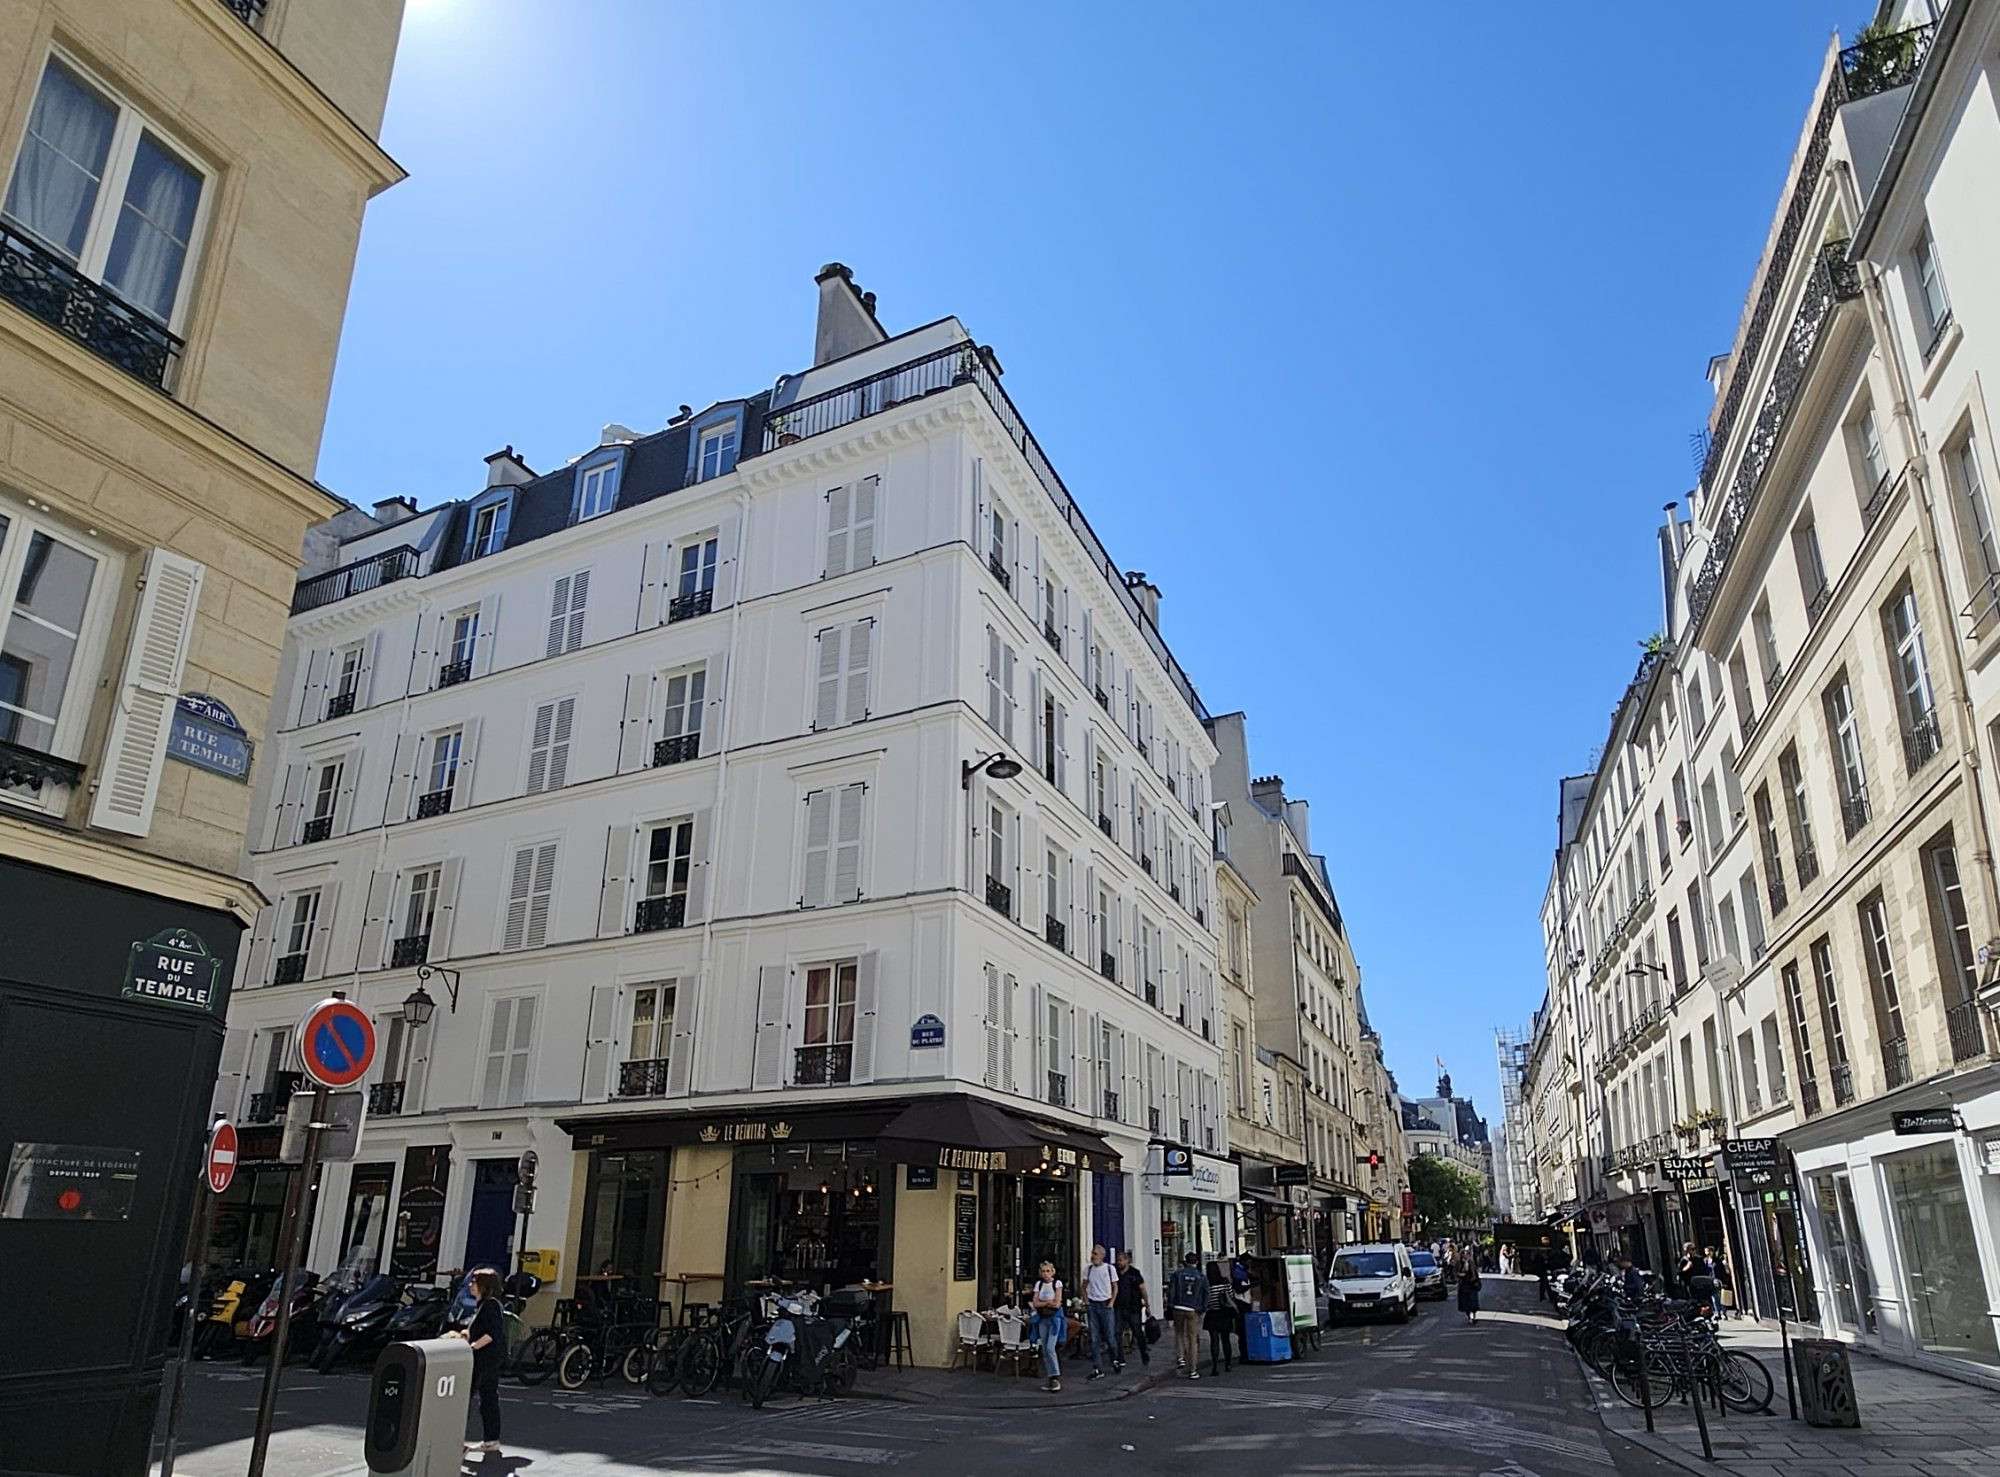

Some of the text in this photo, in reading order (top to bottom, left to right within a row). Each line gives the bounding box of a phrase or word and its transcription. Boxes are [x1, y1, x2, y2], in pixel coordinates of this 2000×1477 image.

[184, 725, 218, 748] RUE
[180, 739, 241, 770] TEMPLE
[157, 955, 195, 975] RUE
[167, 973, 181, 983] DU
[135, 977, 207, 1003] TEMPLE
[1726, 1139, 1772, 1153] CHEAP
[1663, 1159, 1703, 1170] SUAN
[48, 1170, 79, 1178] DEPUIS
[1666, 1169, 1702, 1179] THAI
[437, 1374, 456, 1397] 01
